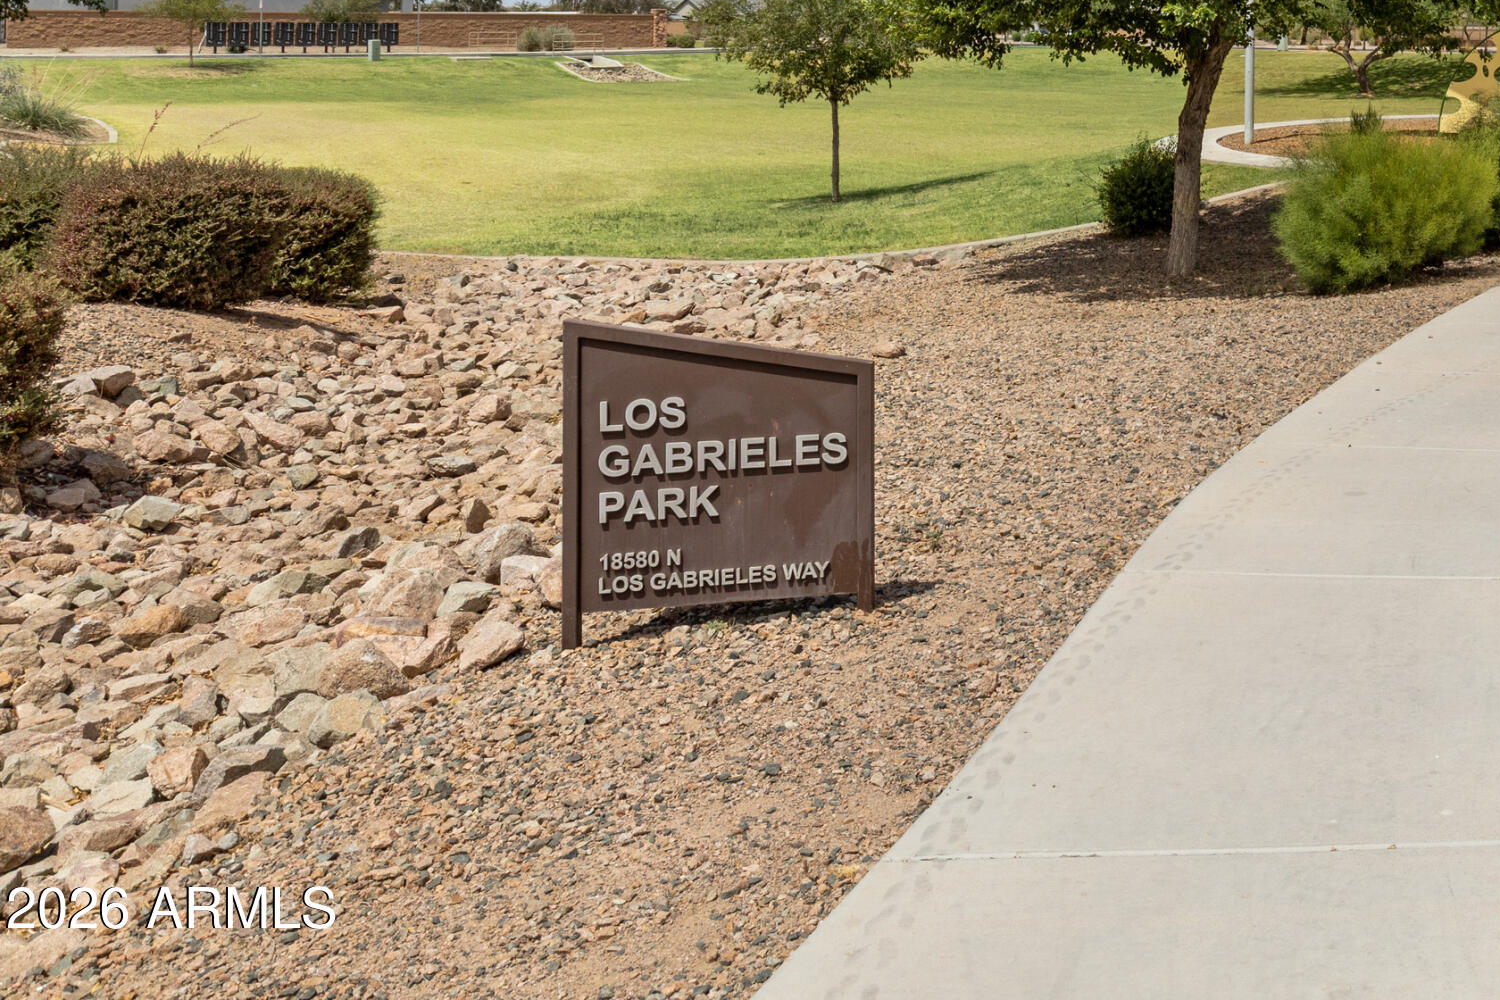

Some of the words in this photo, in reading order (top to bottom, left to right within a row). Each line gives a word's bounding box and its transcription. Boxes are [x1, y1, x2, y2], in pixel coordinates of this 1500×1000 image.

[599, 396, 686, 432] LOS
[598, 432, 848, 477] GABRIELES
[599, 485, 719, 524] PARK
[598, 574, 643, 594] LOS
[650, 564, 777, 589] GABRIELES
[783, 560, 830, 581] WAY
[600, 550, 660, 571] 18580
[666, 549, 681, 566] N
